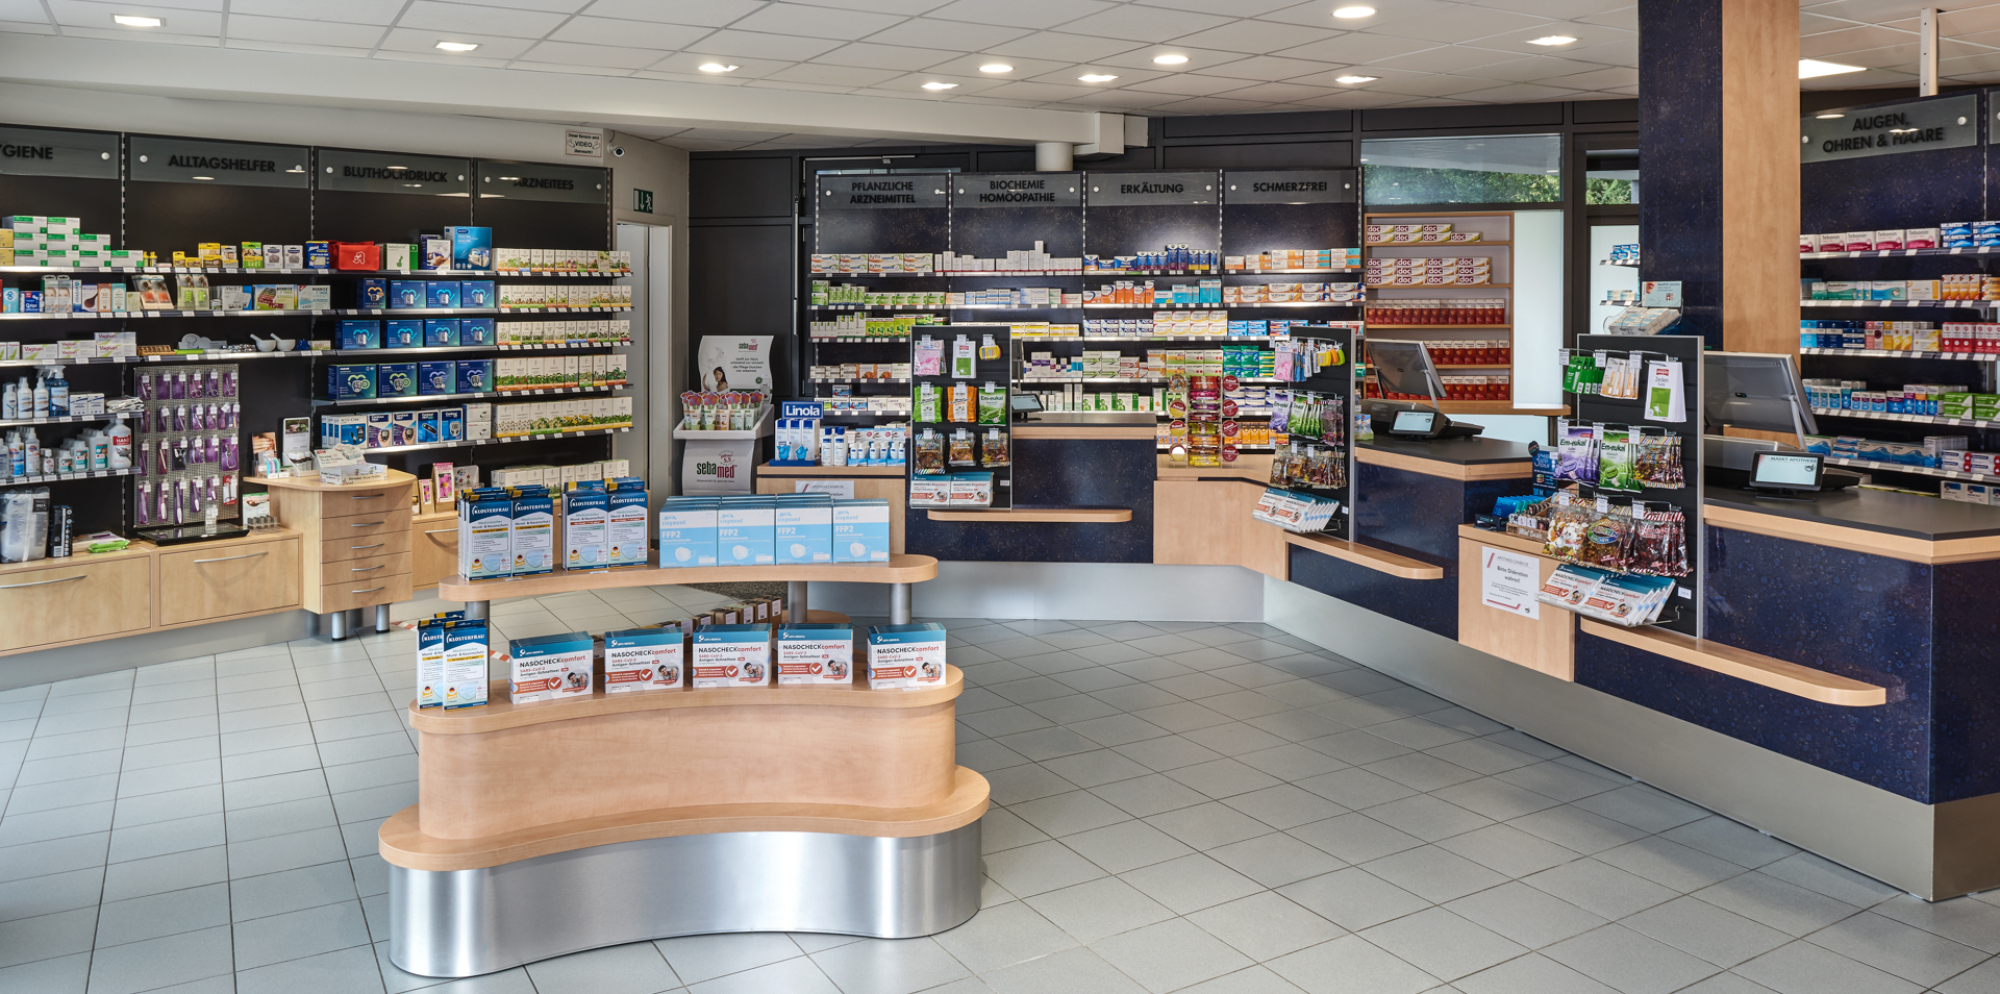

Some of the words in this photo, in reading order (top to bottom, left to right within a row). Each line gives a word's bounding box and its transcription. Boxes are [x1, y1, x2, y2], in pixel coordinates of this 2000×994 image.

[1852, 112, 1911, 131] AUGEN,
[1822, 136, 1872, 153] OHREN
[1877, 134, 1888, 148] &
[1892, 127, 1944, 145] HAARE
[0, 144, 53, 159] GIENE
[168, 155, 276, 172] ALLTAGSHELFER
[343, 166, 448, 182] BLUTHOCHDRUCK
[514, 177, 574, 190] ARZNEITEES
[852, 181, 914, 192] PFLANZLICHE
[990, 180, 1045, 190] BIOCHEMIE
[1120, 182, 1184, 194] ERKÄLTUNG
[1253, 182, 1327, 192] SCHMERZFREI
[850, 194, 916, 204] ARZNEIMITTEL
[980, 190, 1055, 202] HOMÖOPATHIE
[786, 405, 820, 416] Linola
[1601, 443, 1626, 452] Em-eukal
[697, 461, 734, 478] sebamed
[720, 528, 738, 536] FFP2
[777, 527, 796, 535] FFP2
[449, 634, 484, 642] KLOSTERFRAU
